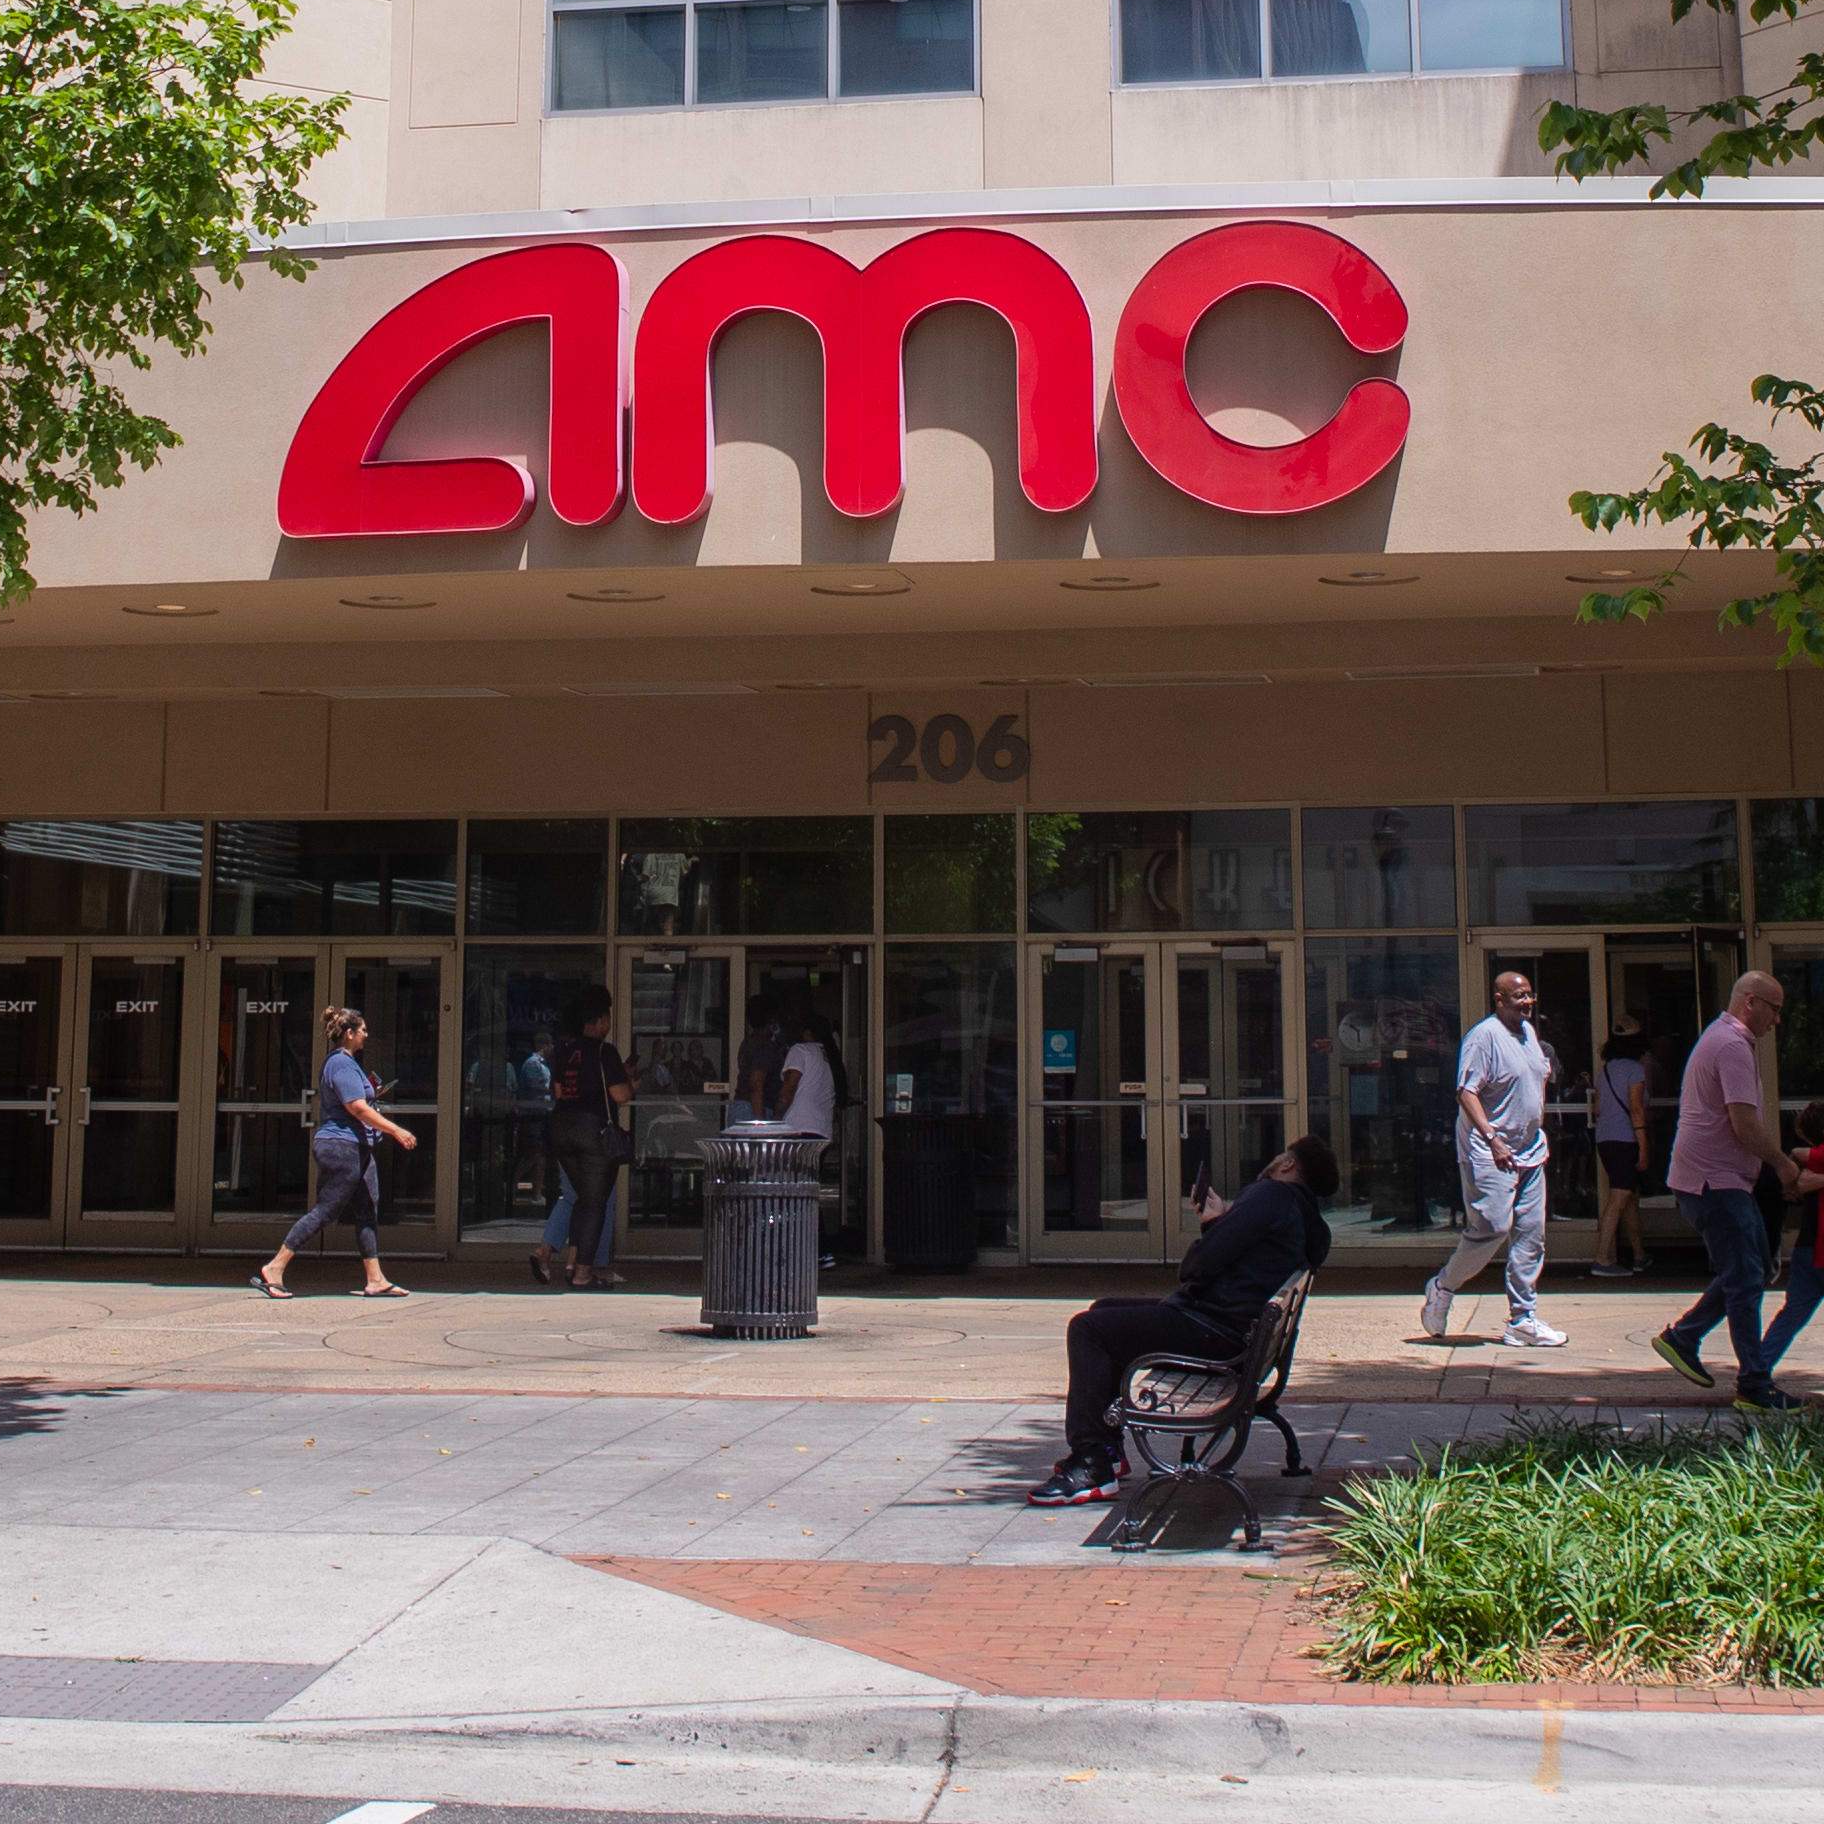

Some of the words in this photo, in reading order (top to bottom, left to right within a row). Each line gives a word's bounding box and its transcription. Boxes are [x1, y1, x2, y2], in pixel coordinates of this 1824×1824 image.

[277, 220, 1412, 540] amc
[866, 713, 1032, 784] 206
[115, 1000, 159, 1013] EXIT
[246, 1001, 289, 1014] EXIT
